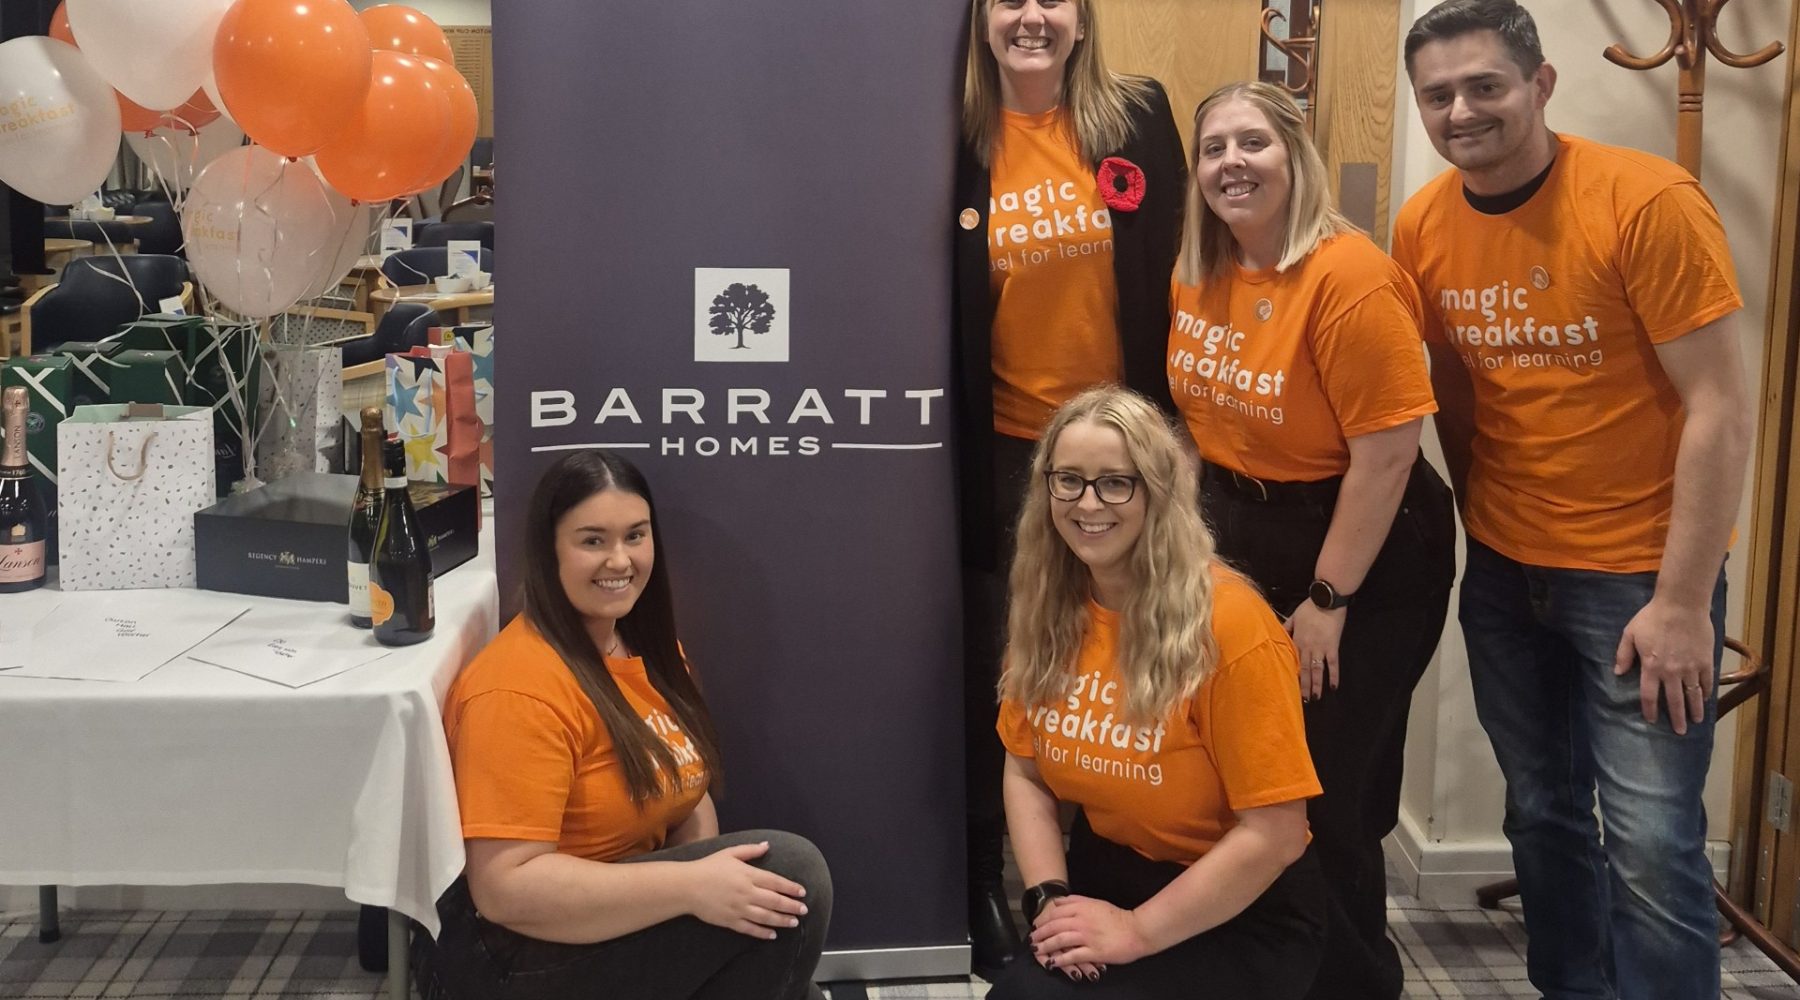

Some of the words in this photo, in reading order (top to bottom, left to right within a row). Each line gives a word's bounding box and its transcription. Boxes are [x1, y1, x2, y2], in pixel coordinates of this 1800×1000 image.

[0, 95, 37, 117] agic
[0, 101, 76, 134] reakfast
[987, 205, 1113, 248] reakfa
[1022, 247, 1051, 266] for
[1059, 238, 1113, 260] learn
[1440, 280, 1529, 323] magic
[1175, 309, 1246, 356] magic
[1170, 348, 1285, 397] reakfast
[1478, 351, 1505, 370] for
[1511, 349, 1604, 370] learning
[530, 387, 945, 428] BARRATT
[1183, 377, 1209, 398] for
[1211, 386, 1284, 425] learning
[660, 436, 821, 457] HOMES
[1060, 670, 1118, 711] gic
[1026, 702, 1166, 753] reakfast
[1045, 738, 1069, 764] for
[1074, 746, 1164, 786] learning
